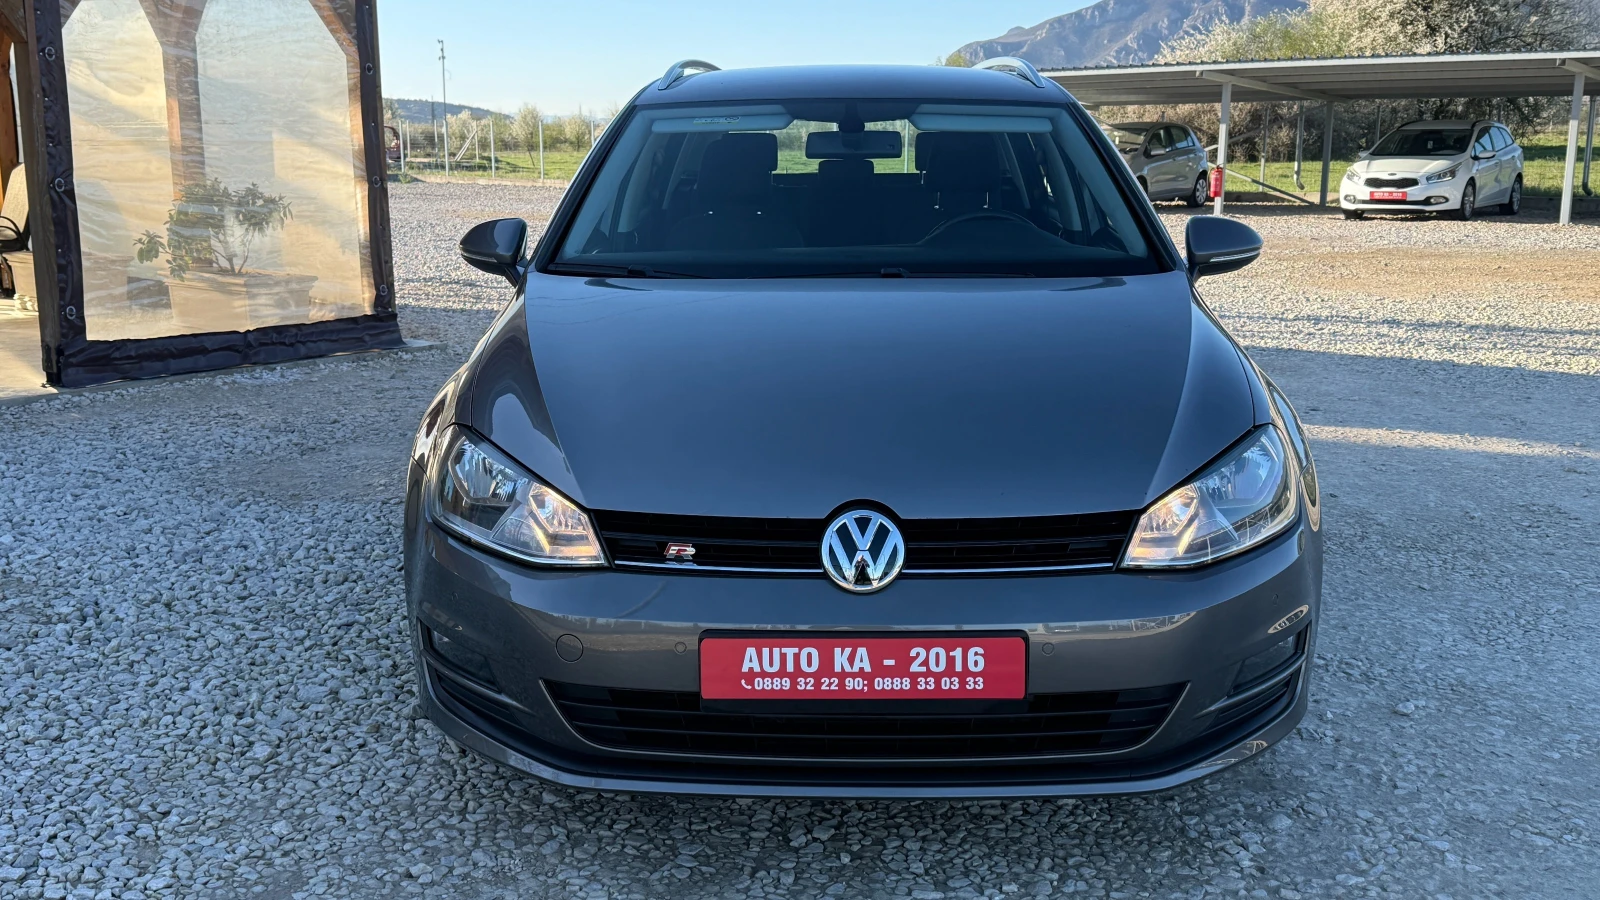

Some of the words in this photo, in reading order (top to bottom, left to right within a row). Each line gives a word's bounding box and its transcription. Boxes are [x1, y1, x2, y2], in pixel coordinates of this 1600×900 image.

[824, 511, 903, 591] VW
[741, 646, 820, 673] AUTO
[834, 646, 872, 673] KA
[909, 646, 985, 673] 2016
[754, 677, 791, 691] 0889
[796, 677, 815, 691] 32
[820, 677, 839, 691] 22
[844, 677, 868, 693] 90;
[874, 677, 911, 691] 0888
[917, 676, 935, 690] 33
[941, 676, 960, 690] 03
[965, 676, 984, 690] 33
